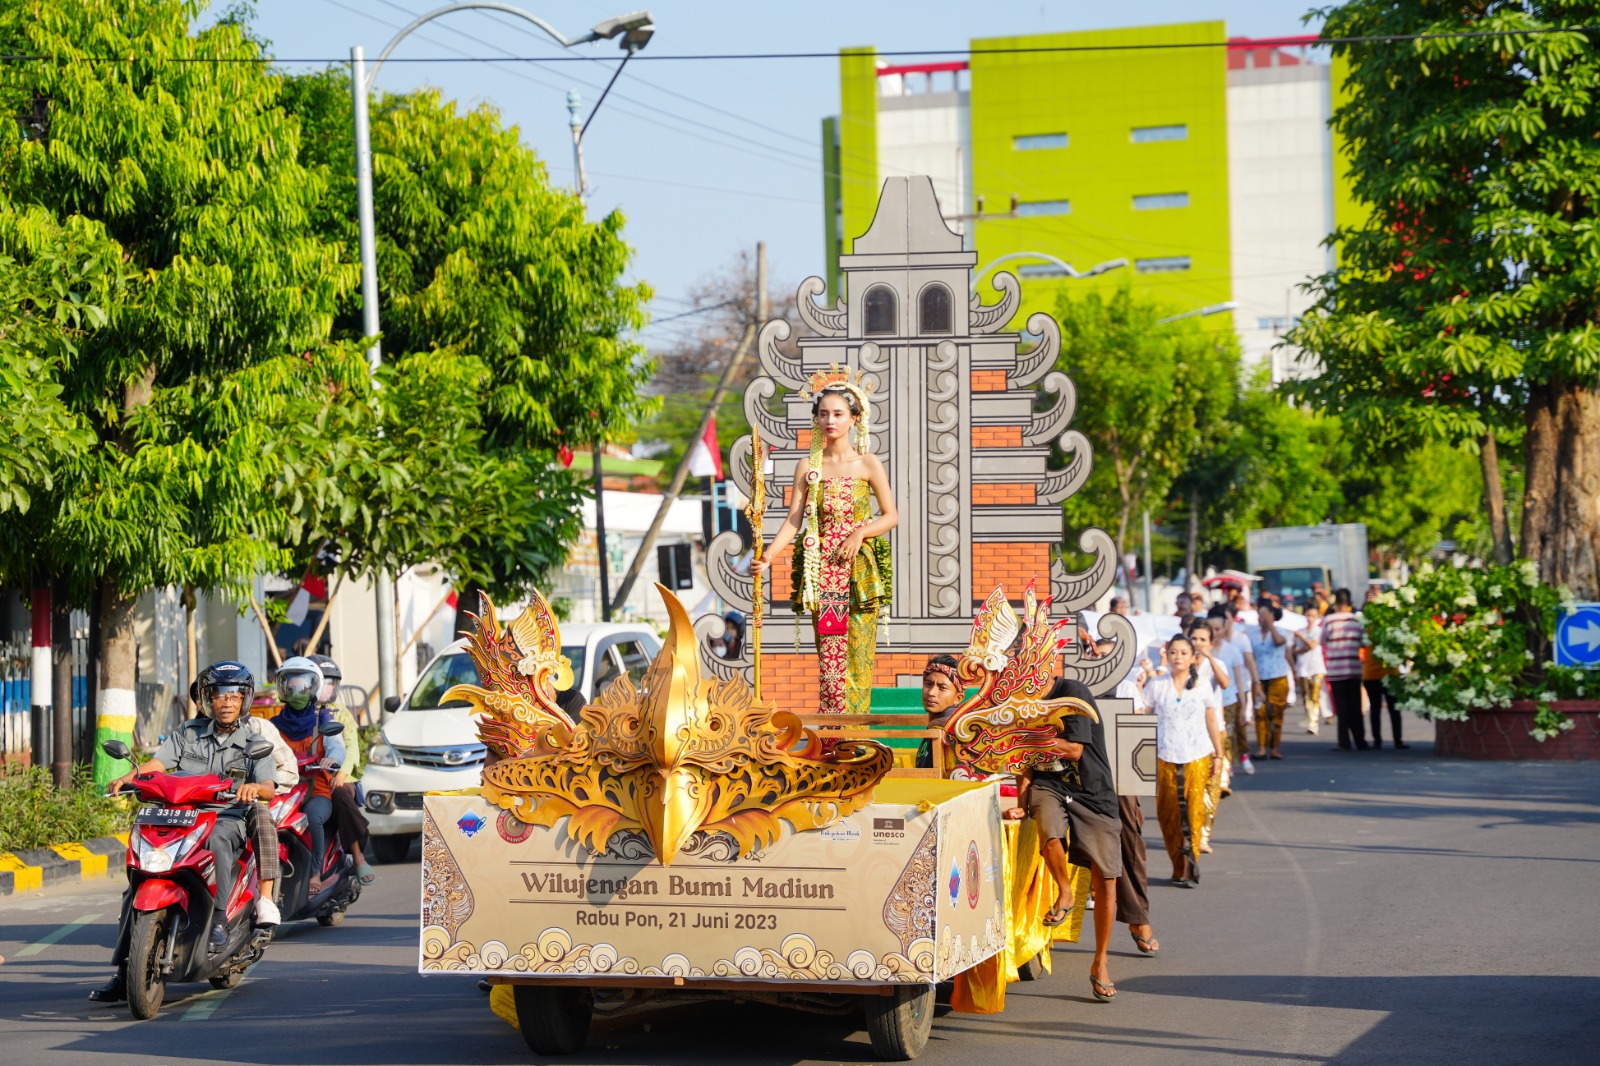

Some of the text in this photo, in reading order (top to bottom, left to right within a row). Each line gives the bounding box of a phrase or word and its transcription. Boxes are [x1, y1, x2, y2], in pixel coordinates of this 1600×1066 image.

[138, 808, 198, 818] AE 3319 BU
[521, 872, 834, 900] Wilujengan Bumi Madiun
[576, 910, 777, 930] Rabu Pon, 21 Juni 2023
